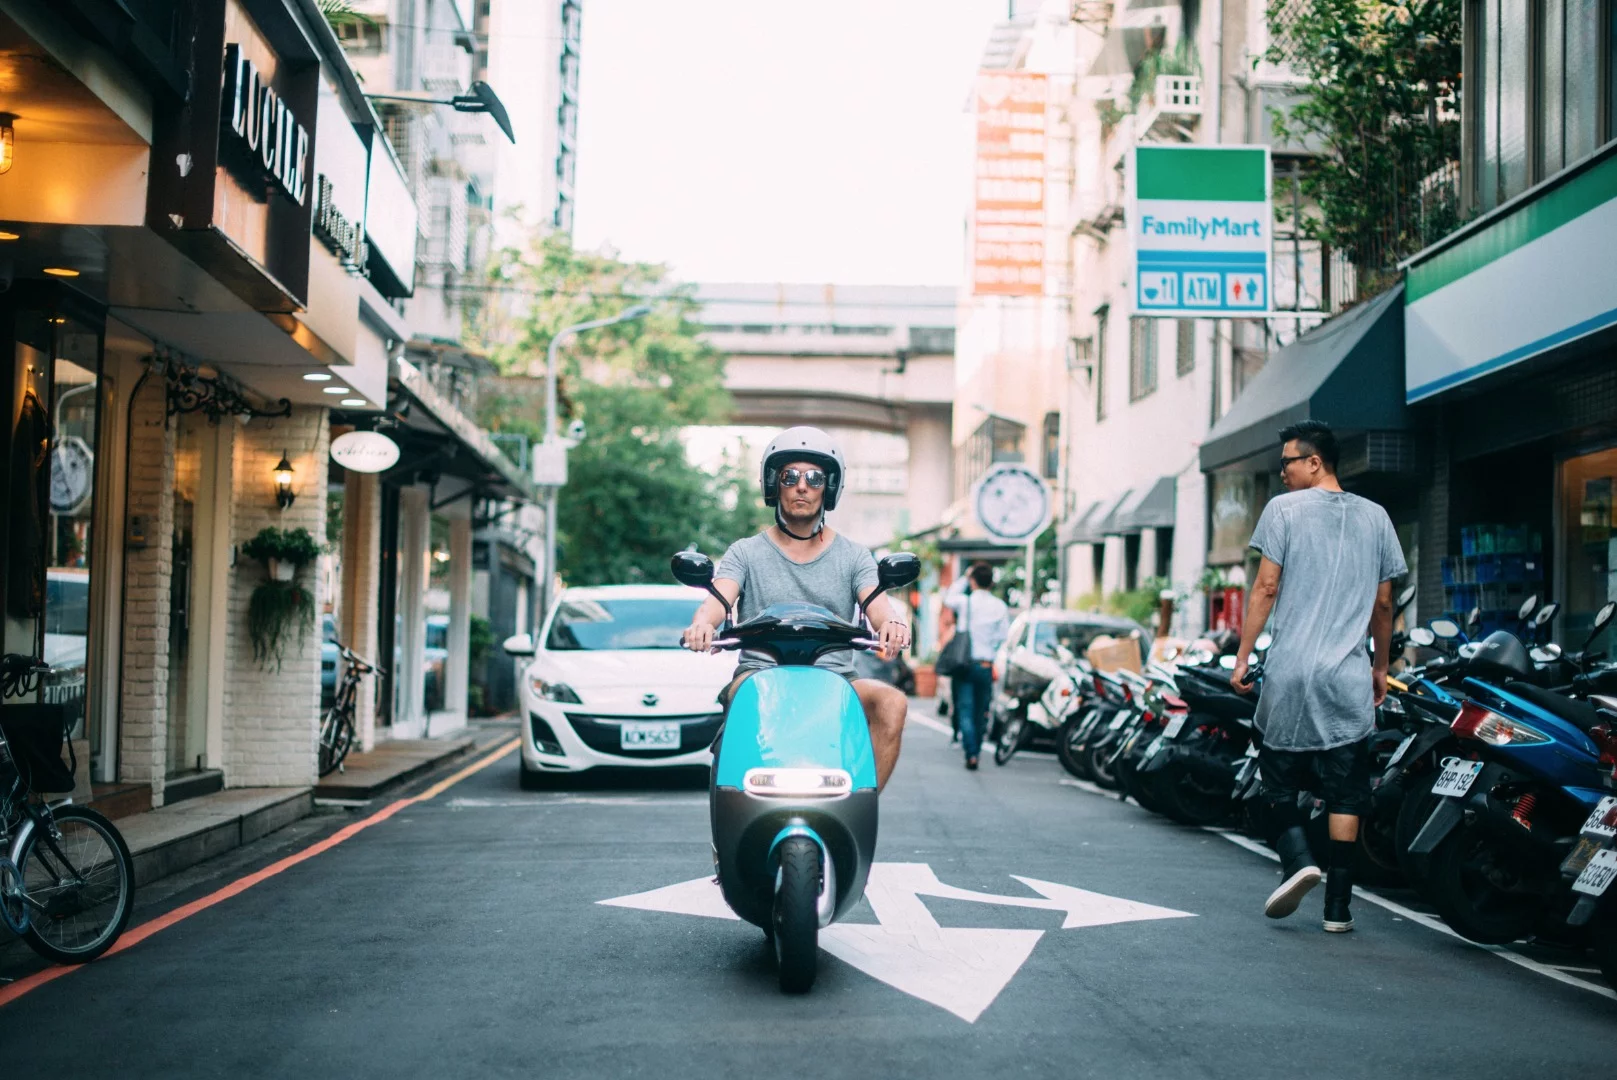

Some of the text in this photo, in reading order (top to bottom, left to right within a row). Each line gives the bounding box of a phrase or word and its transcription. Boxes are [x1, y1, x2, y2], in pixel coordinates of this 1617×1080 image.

[231, 42, 309, 207] LUCILE
[1141, 216, 1260, 241] FamilyMart
[1187, 277, 1218, 300] ATM
